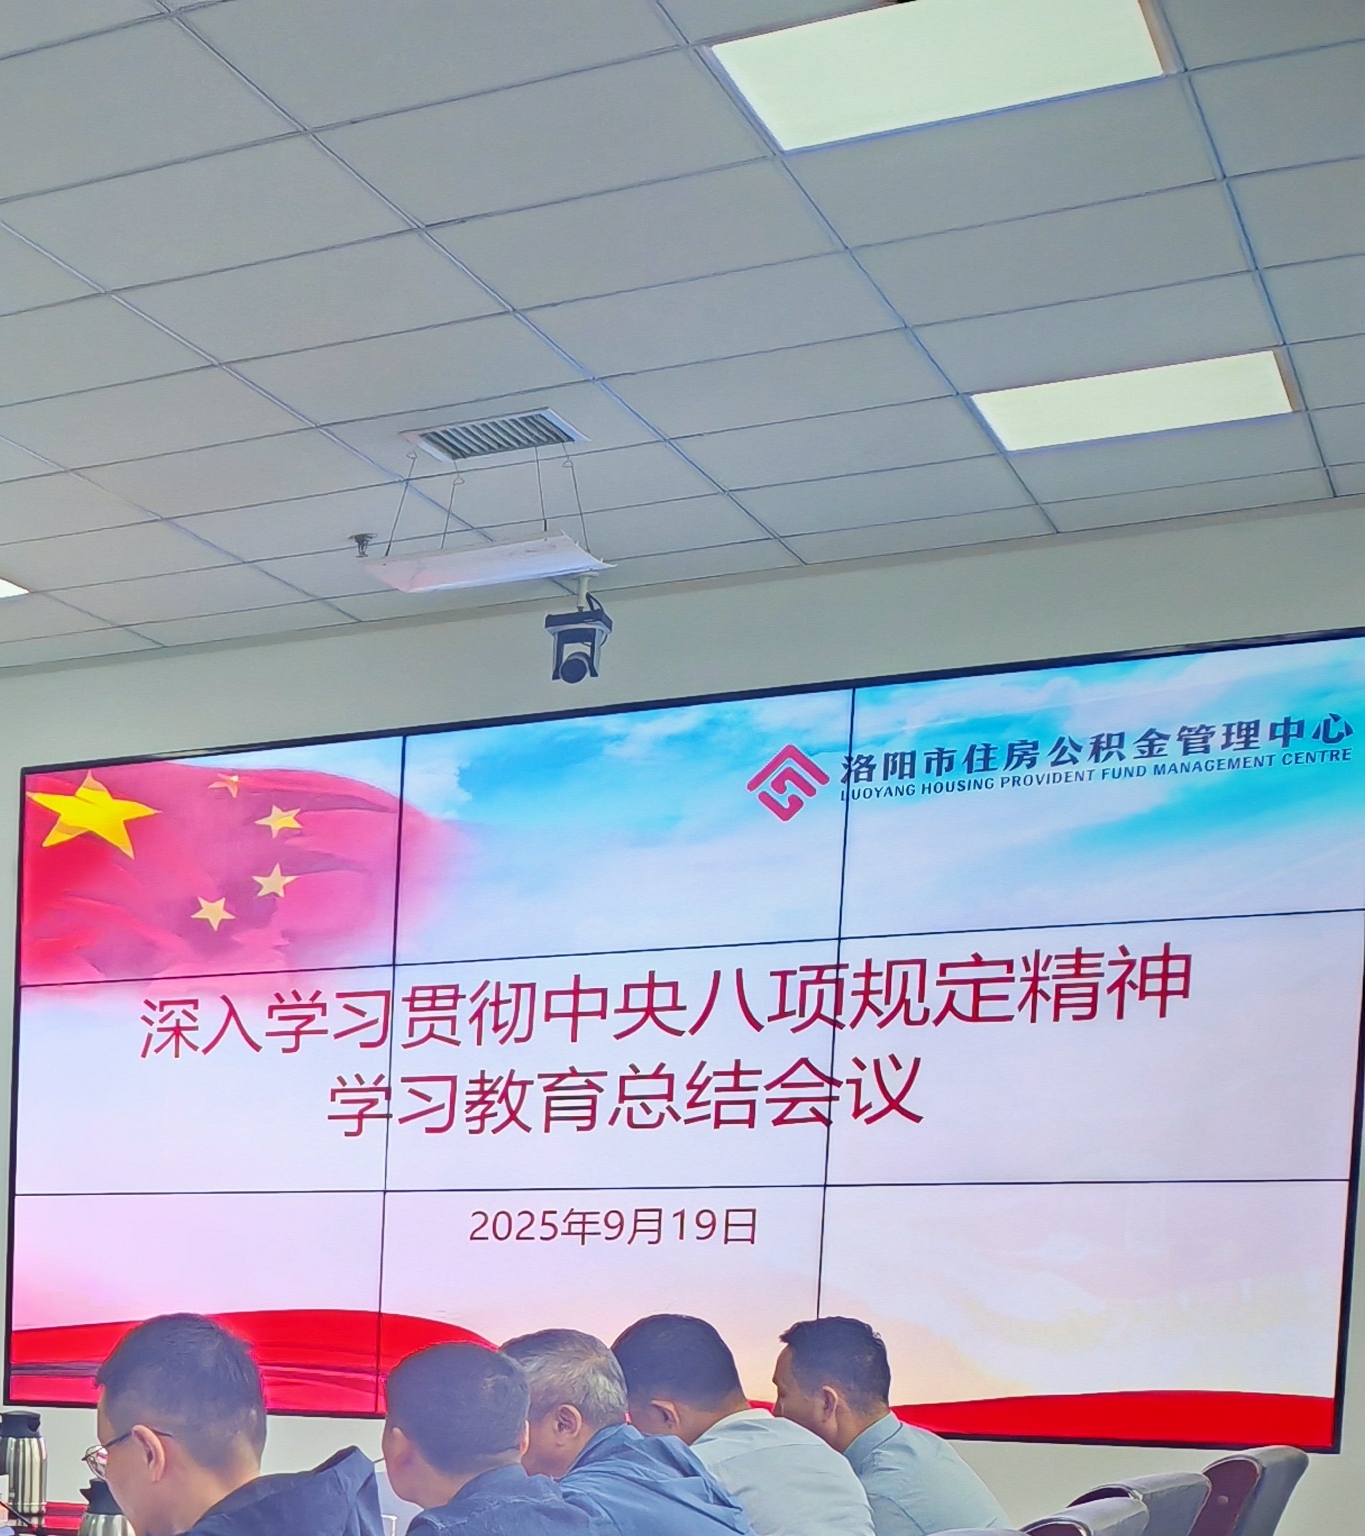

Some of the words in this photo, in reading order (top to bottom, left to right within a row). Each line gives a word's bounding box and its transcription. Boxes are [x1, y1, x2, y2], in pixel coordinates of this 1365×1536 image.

[840, 784, 917, 801] LUOYANG
[921, 776, 995, 796] HOUSING
[1000, 768, 1096, 789] PROVIDENT
[1100, 764, 1148, 780] FUND
[1153, 753, 1276, 776] MANAGEMENT
[1282, 747, 1353, 767] CENTRE
[841, 711, 1354, 785] 洛阳市住房公积金管理中心
[139, 940, 1195, 1060] 深入学习贯彻中央八项规定精神
[327, 1054, 925, 1139] 学习教育总结会议
[468, 1205, 758, 1249] 2025年9月19日
